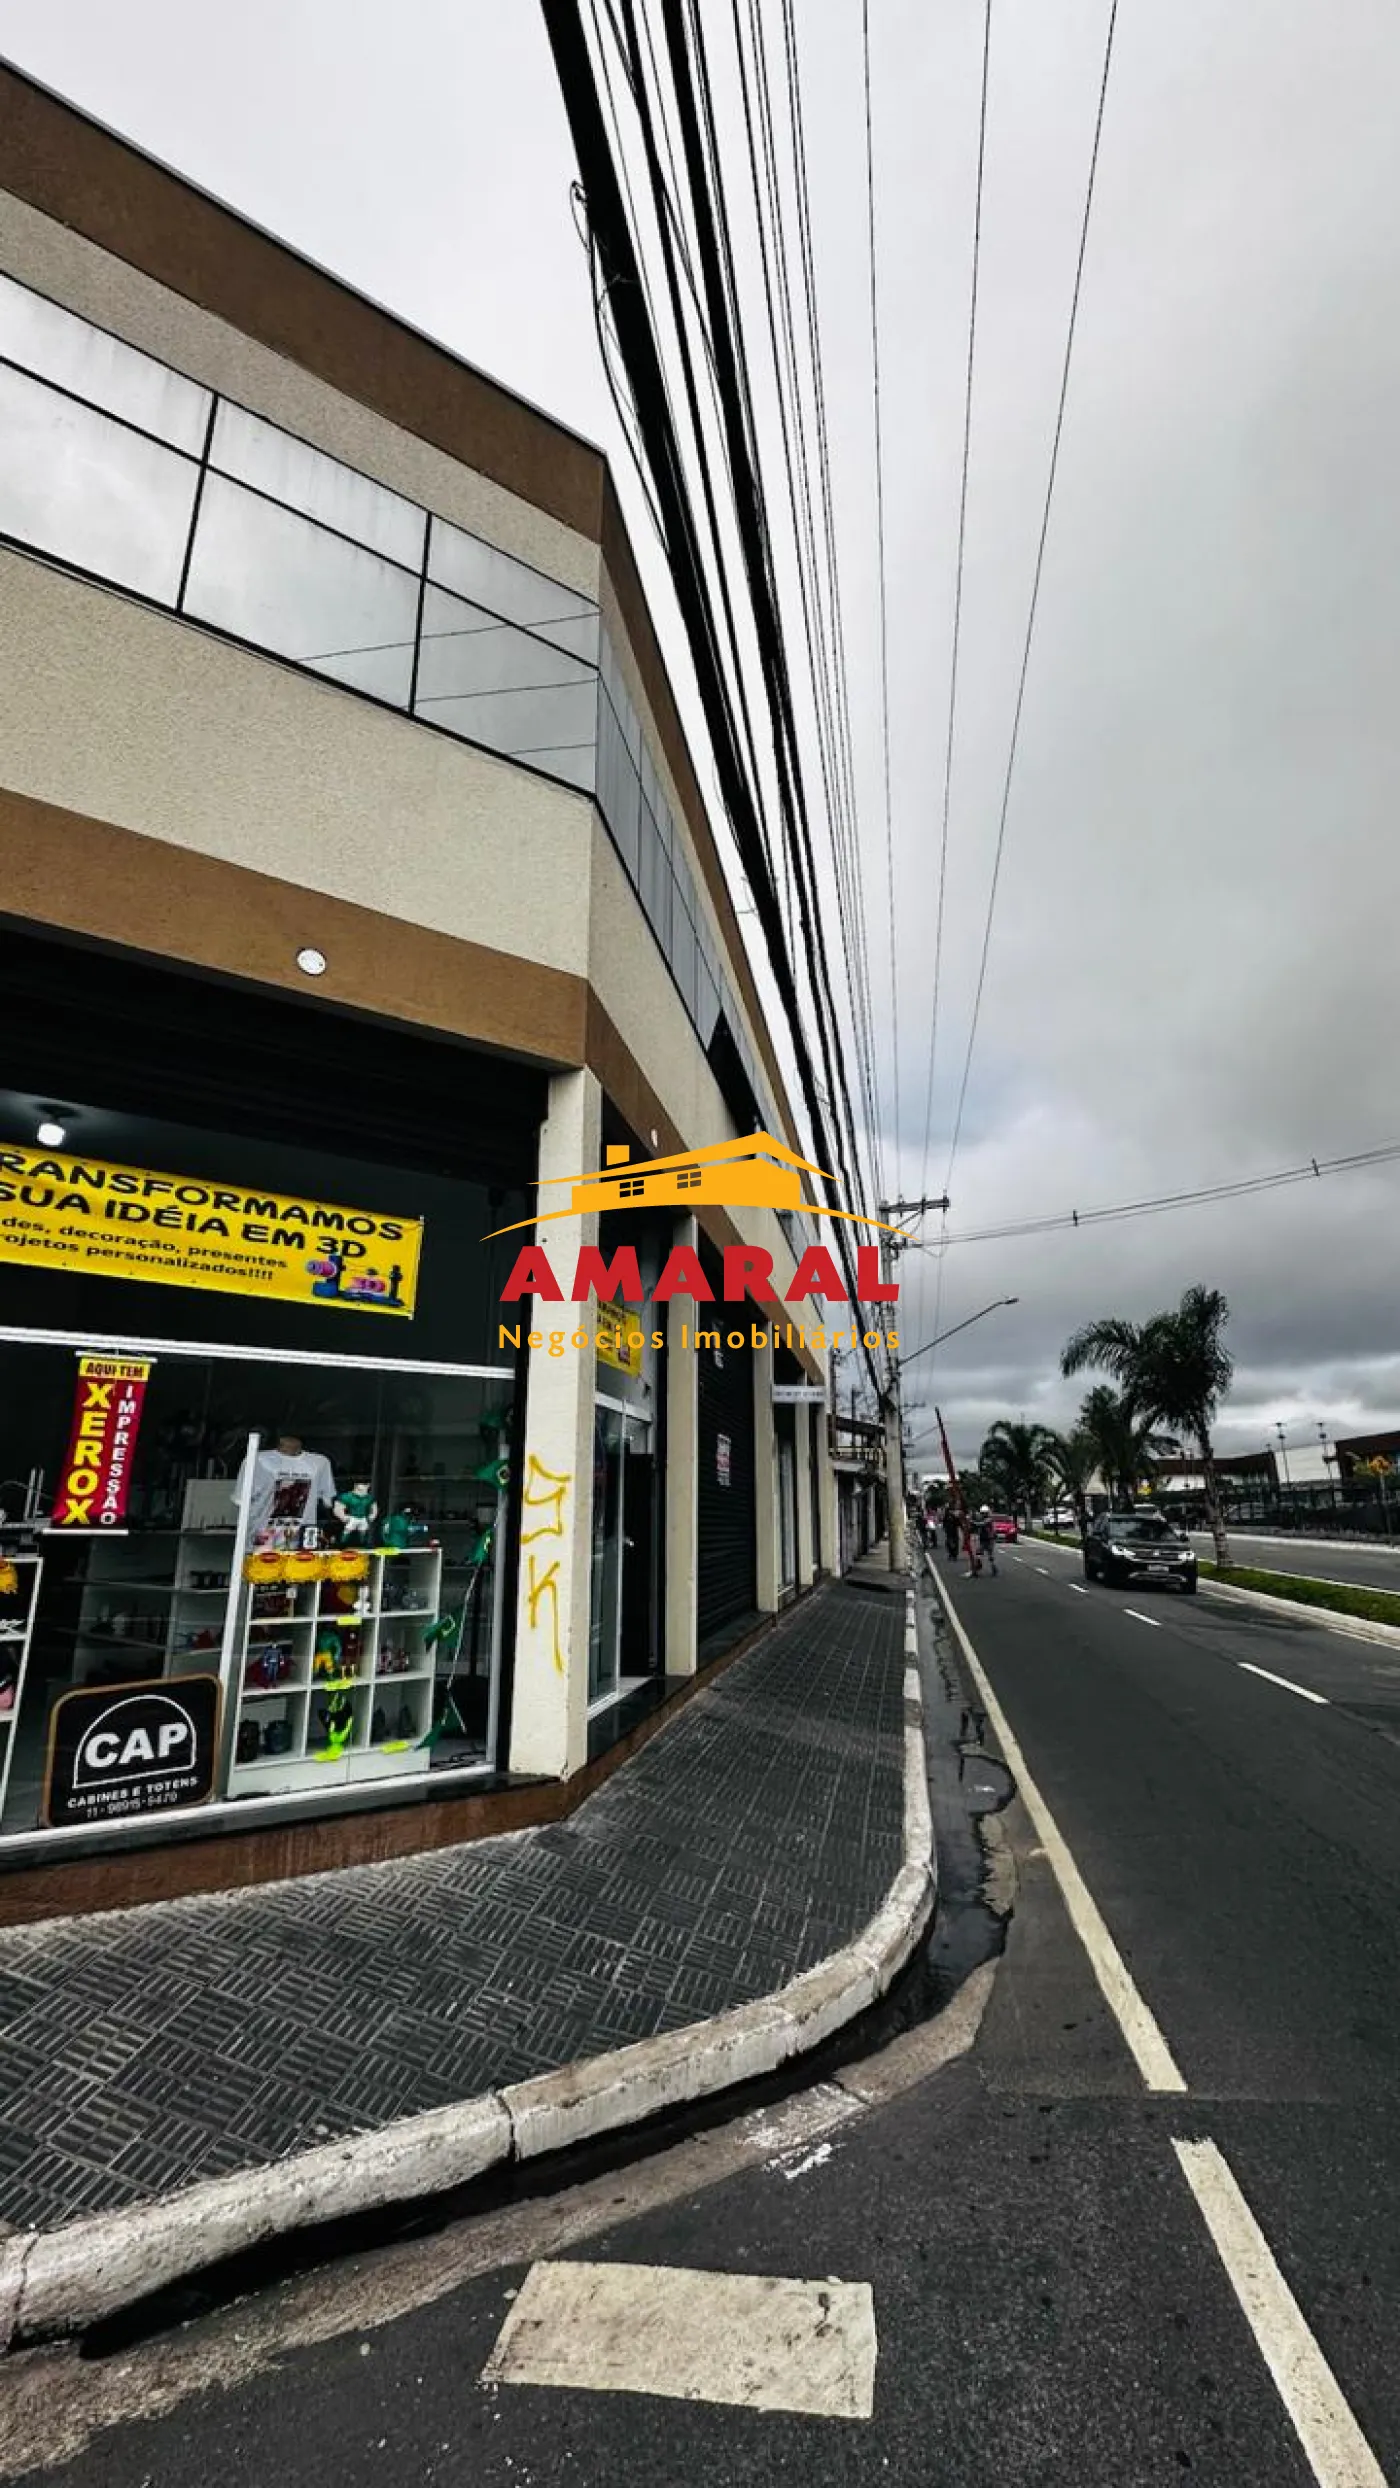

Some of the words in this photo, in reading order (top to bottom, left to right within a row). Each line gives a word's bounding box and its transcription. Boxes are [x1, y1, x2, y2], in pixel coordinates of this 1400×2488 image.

[0, 1181, 90, 1215] SUA
[105, 1199, 229, 1237] IDÉIA
[241, 1223, 305, 1250] EM
[316, 1236, 366, 1258] 3D
[0, 1233, 79, 1252] ojetos
[188, 1246, 287, 1268] presentes
[61, 1382, 114, 1525] XEROX
[84, 1722, 188, 1768] CAP
[146, 1776, 199, 1794] TOTENS
